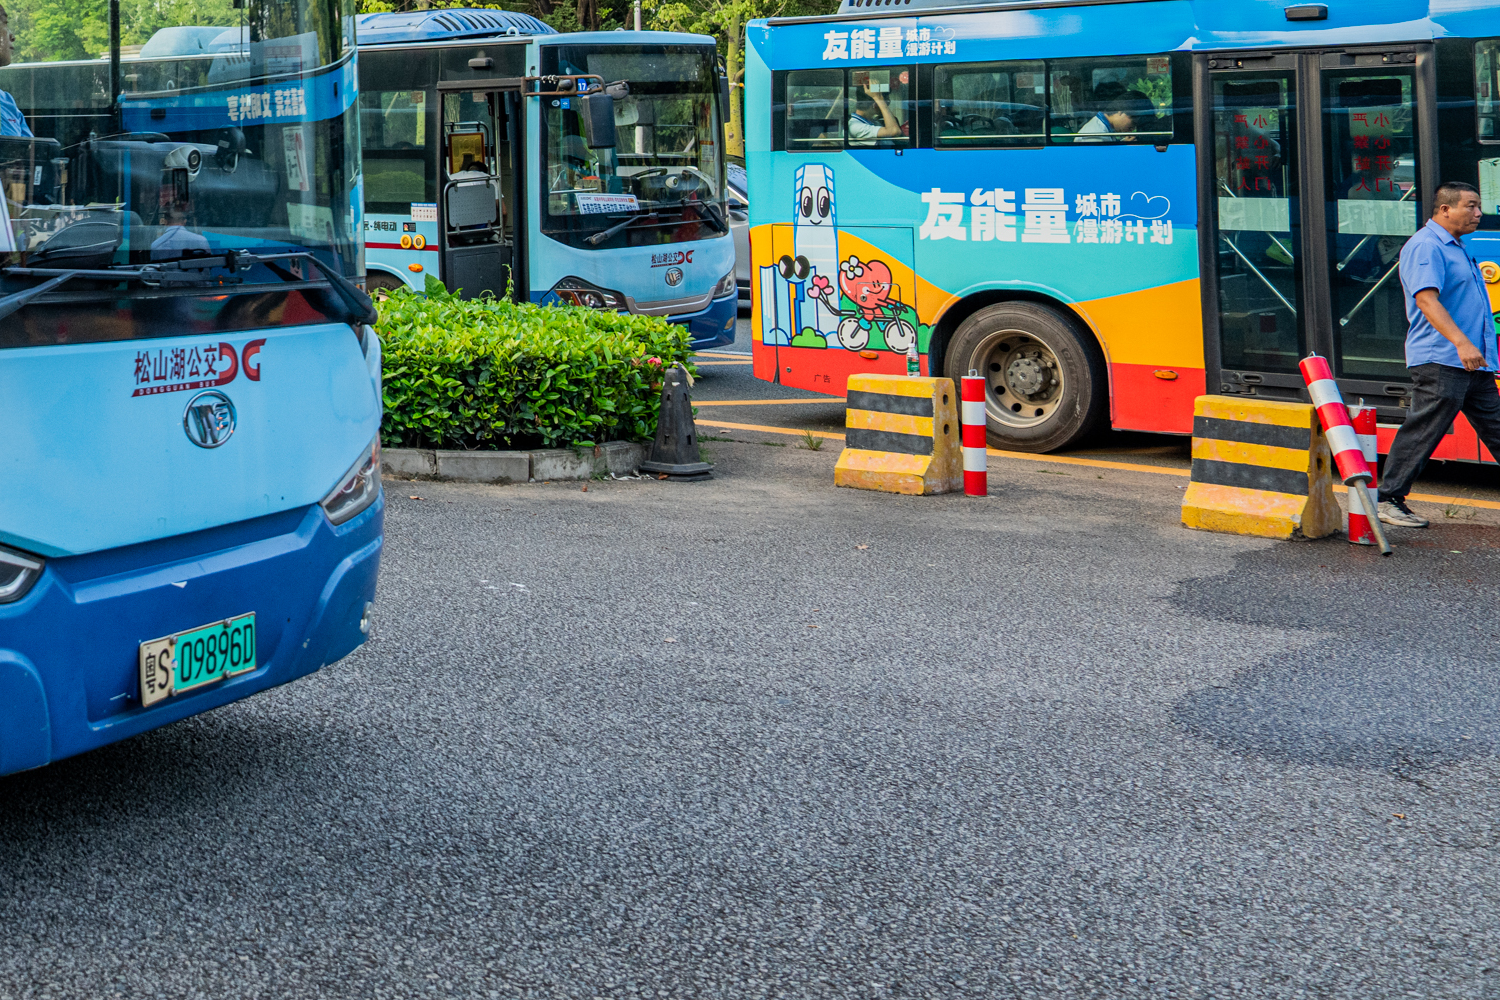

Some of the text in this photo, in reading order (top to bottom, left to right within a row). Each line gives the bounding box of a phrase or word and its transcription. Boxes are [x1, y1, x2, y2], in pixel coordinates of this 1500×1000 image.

[823, 27, 930, 60] 友能量 城市
[906, 41, 956, 57] 漫游计划
[919, 187, 1121, 244] 友能量 城市
[1076, 219, 1173, 245] 漫游计划
[133, 344, 218, 386] 松山湖公交
[814, 373, 831, 383] 广告
[139, 380, 216, 396] DONGGUAN BUS
